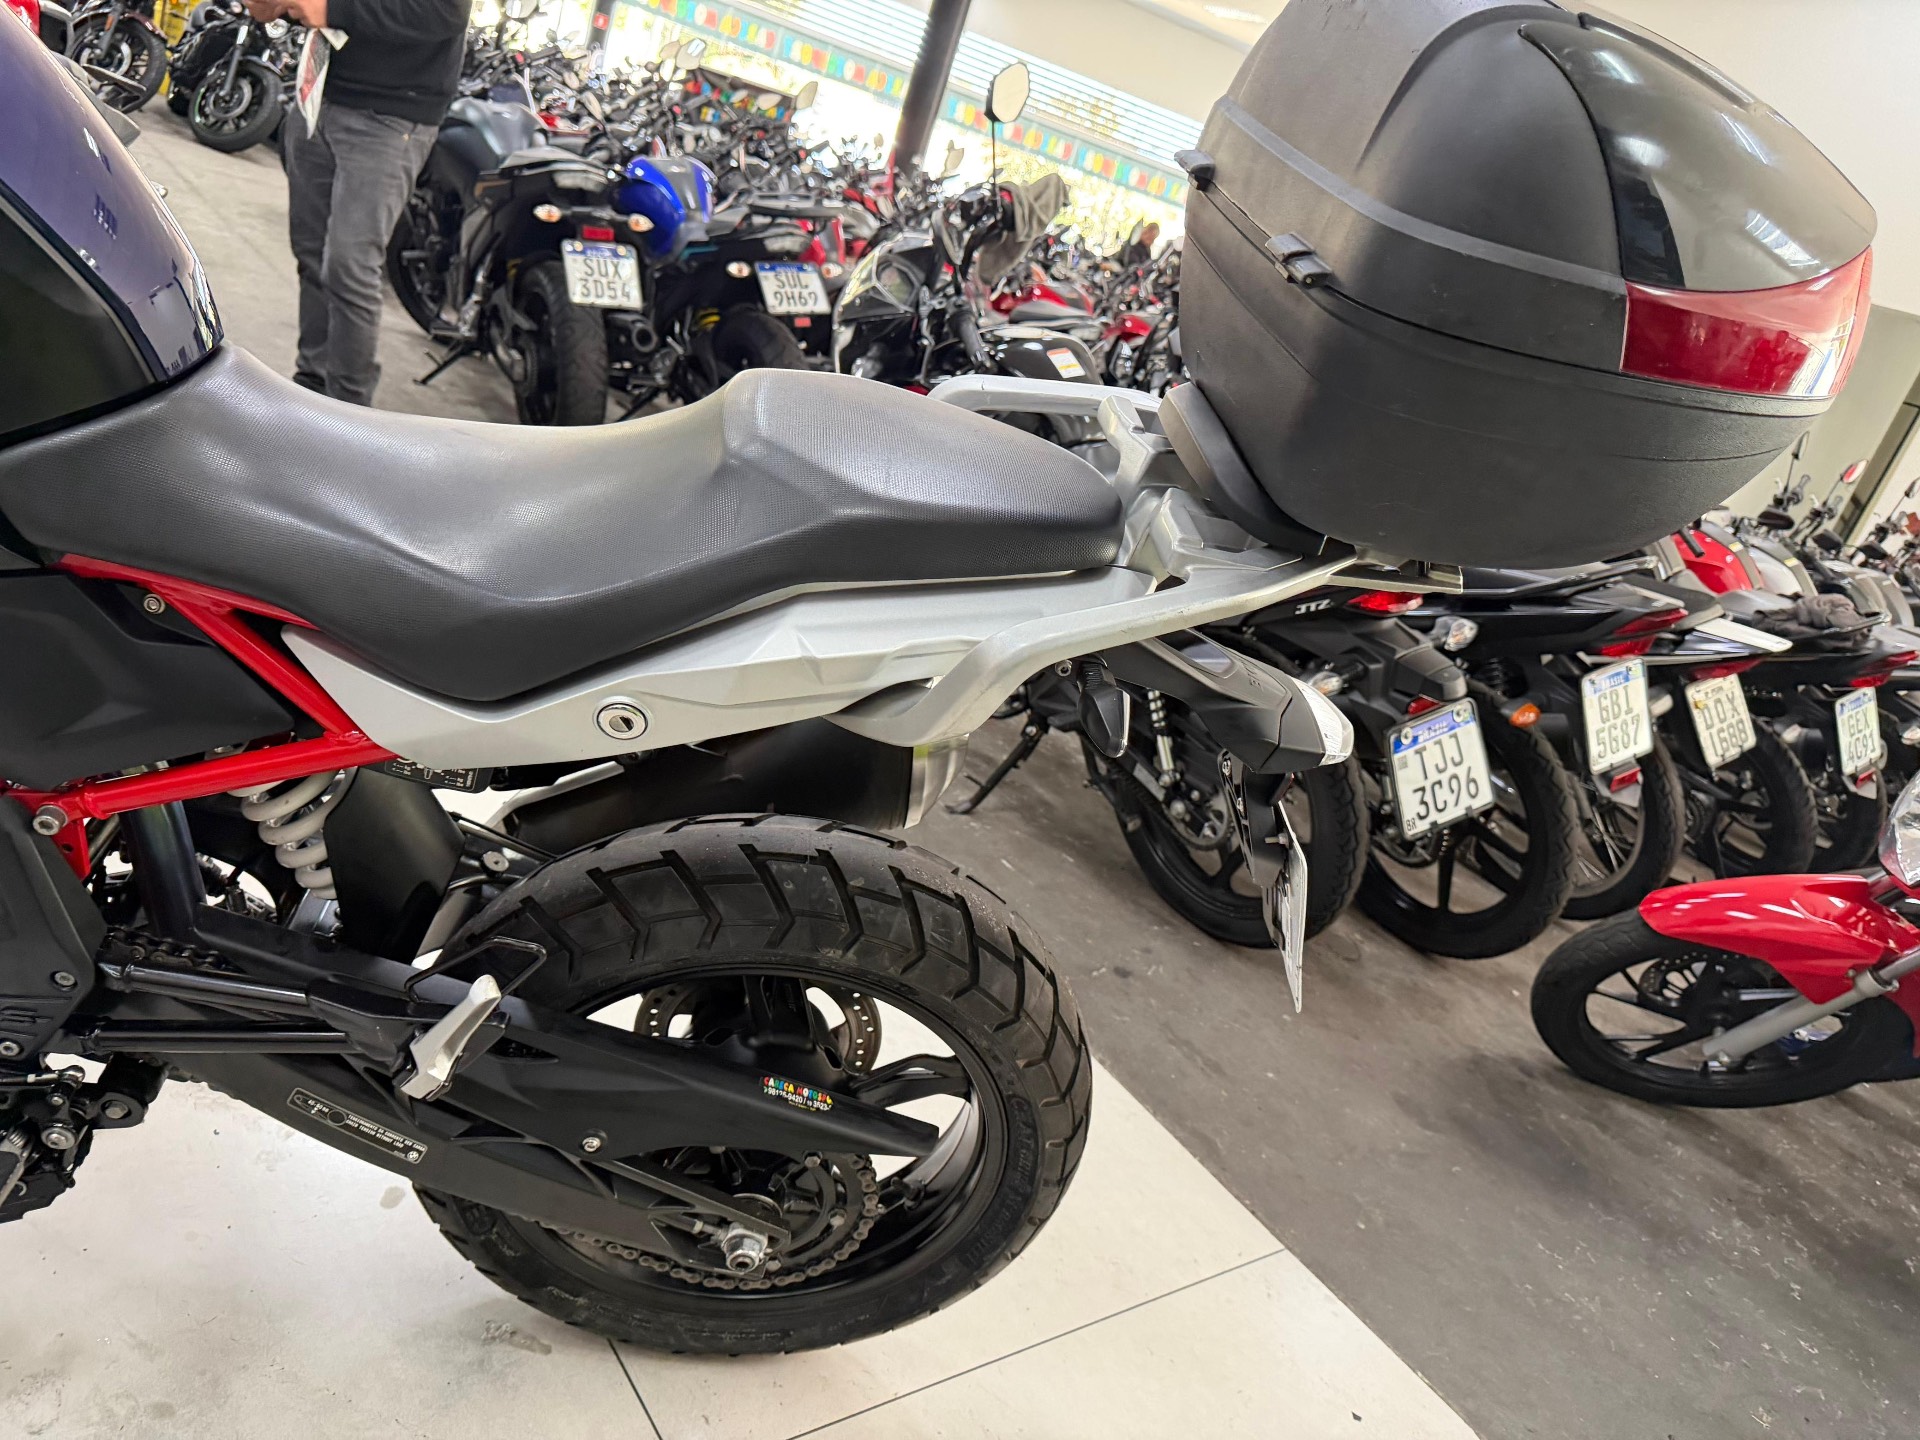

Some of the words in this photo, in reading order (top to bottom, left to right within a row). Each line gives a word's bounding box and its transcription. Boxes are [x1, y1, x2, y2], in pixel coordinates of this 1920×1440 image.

[580, 278, 631, 302] 3D54
[583, 258, 623, 280] SUX
[1597, 685, 1634, 724] GBI
[1414, 732, 1464, 780] TJJ
[1595, 713, 1641, 759] 5G87
[1412, 766, 1480, 820] 3C96
